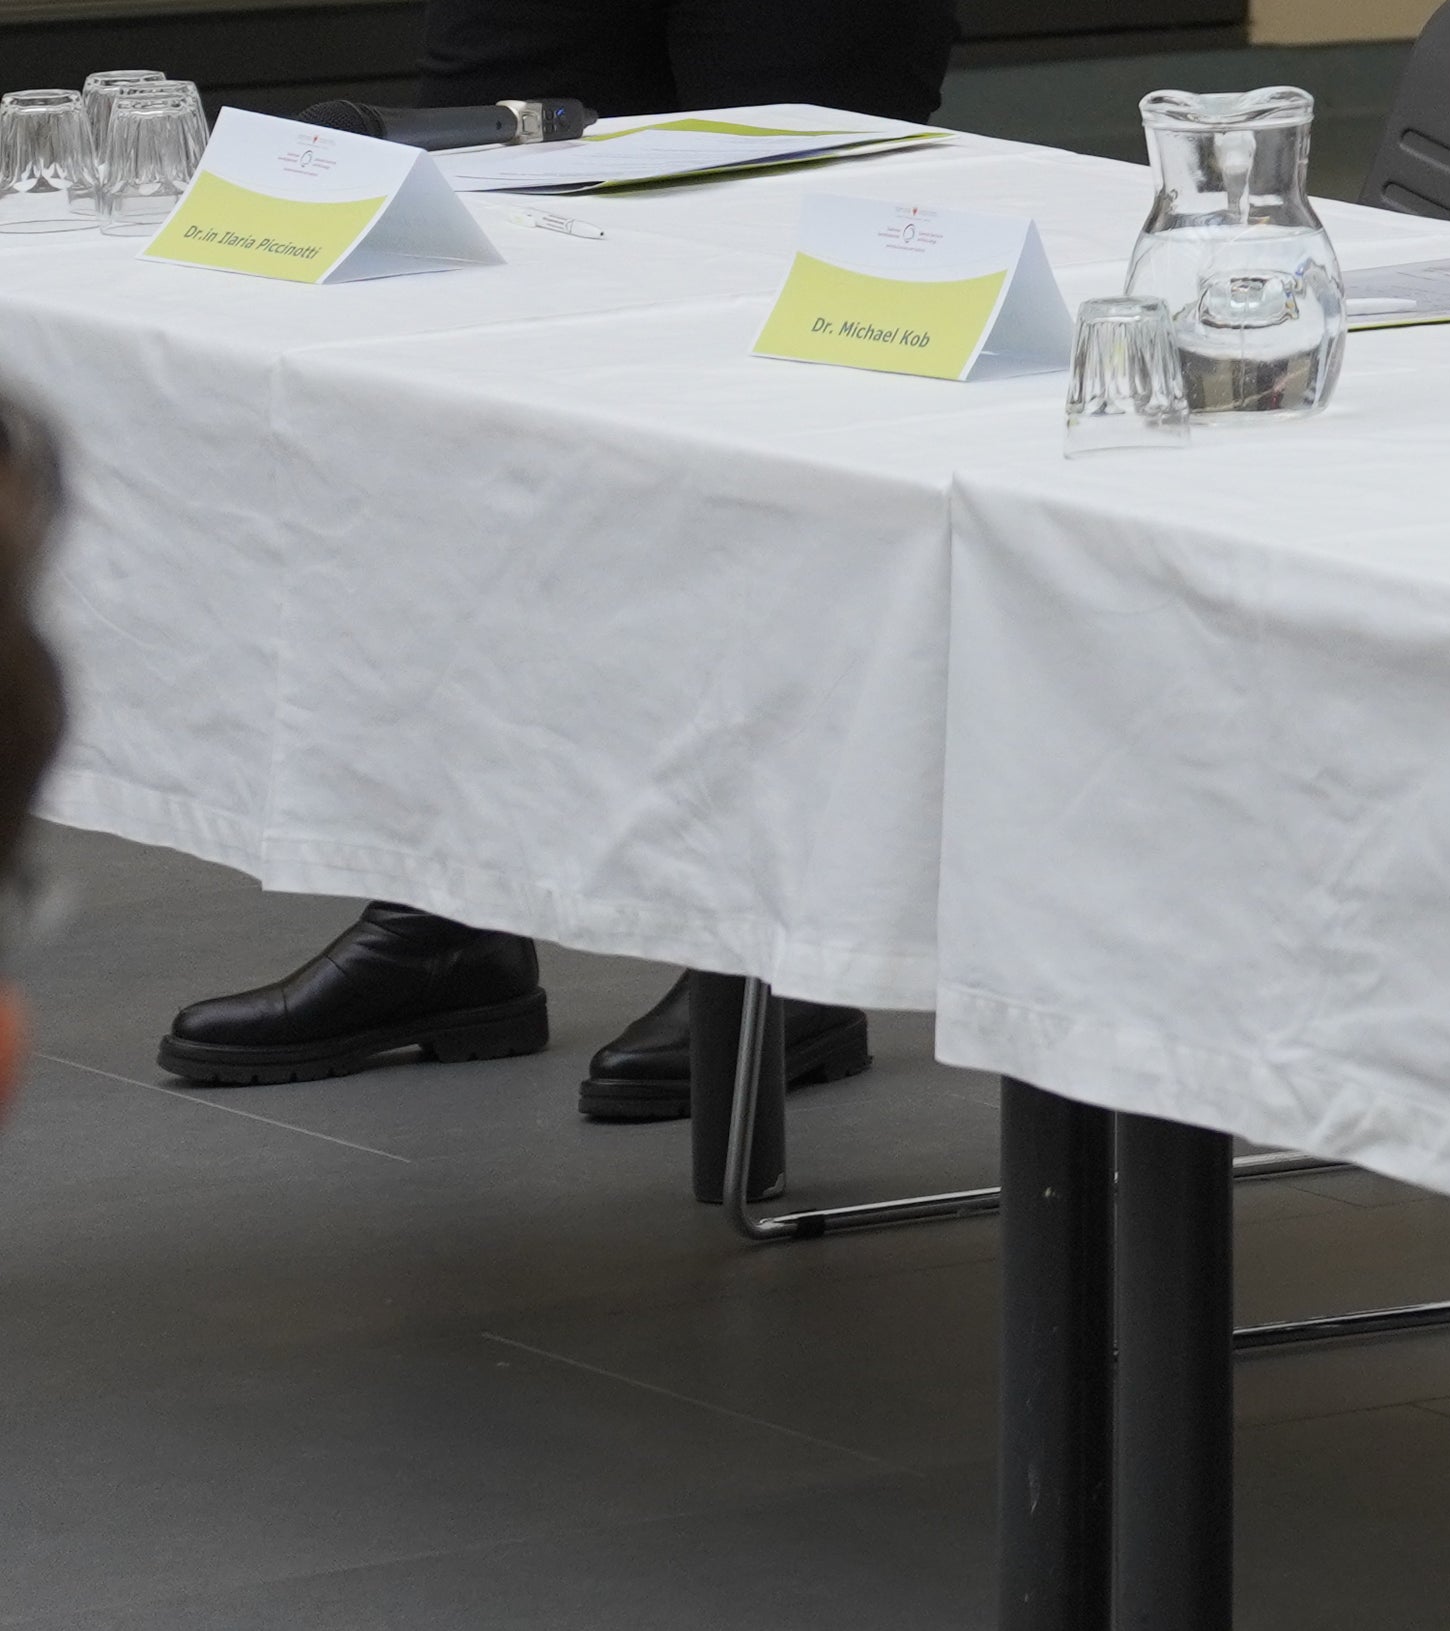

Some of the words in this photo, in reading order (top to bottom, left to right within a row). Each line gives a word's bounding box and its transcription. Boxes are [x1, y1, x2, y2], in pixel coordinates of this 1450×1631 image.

[183, 224, 218, 243] Dr.in
[218, 230, 255, 249] Ilaria
[257, 238, 321, 260] Piccinotti
[811, 317, 834, 334] Dr.
[838, 321, 900, 344] Michael
[899, 330, 930, 349] Kob
